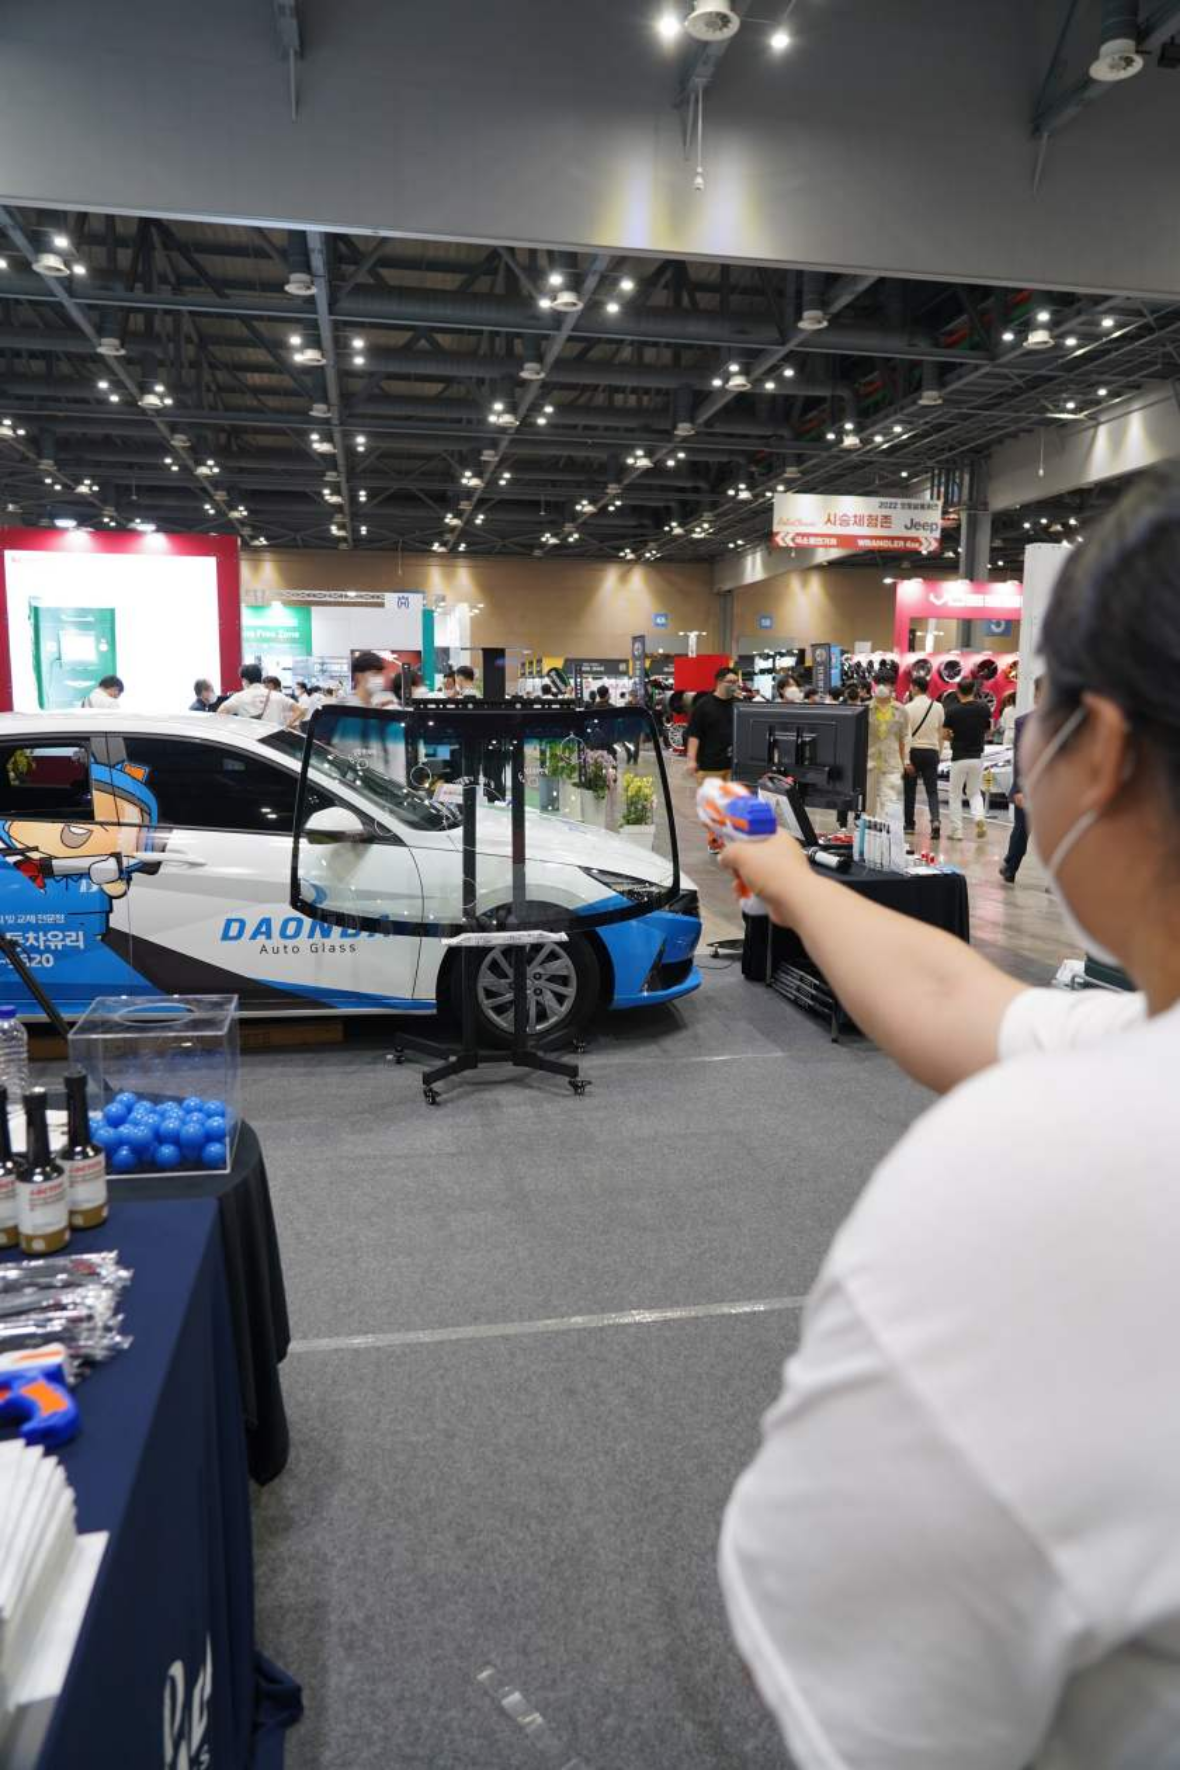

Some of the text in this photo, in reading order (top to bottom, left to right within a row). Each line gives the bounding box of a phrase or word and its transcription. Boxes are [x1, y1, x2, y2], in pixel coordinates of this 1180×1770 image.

[878, 501, 898, 510] 2022
[825, 512, 893, 529] 시승체험존
[904, 518, 939, 534] Jeep
[259, 942, 357, 955] Auto Glass
